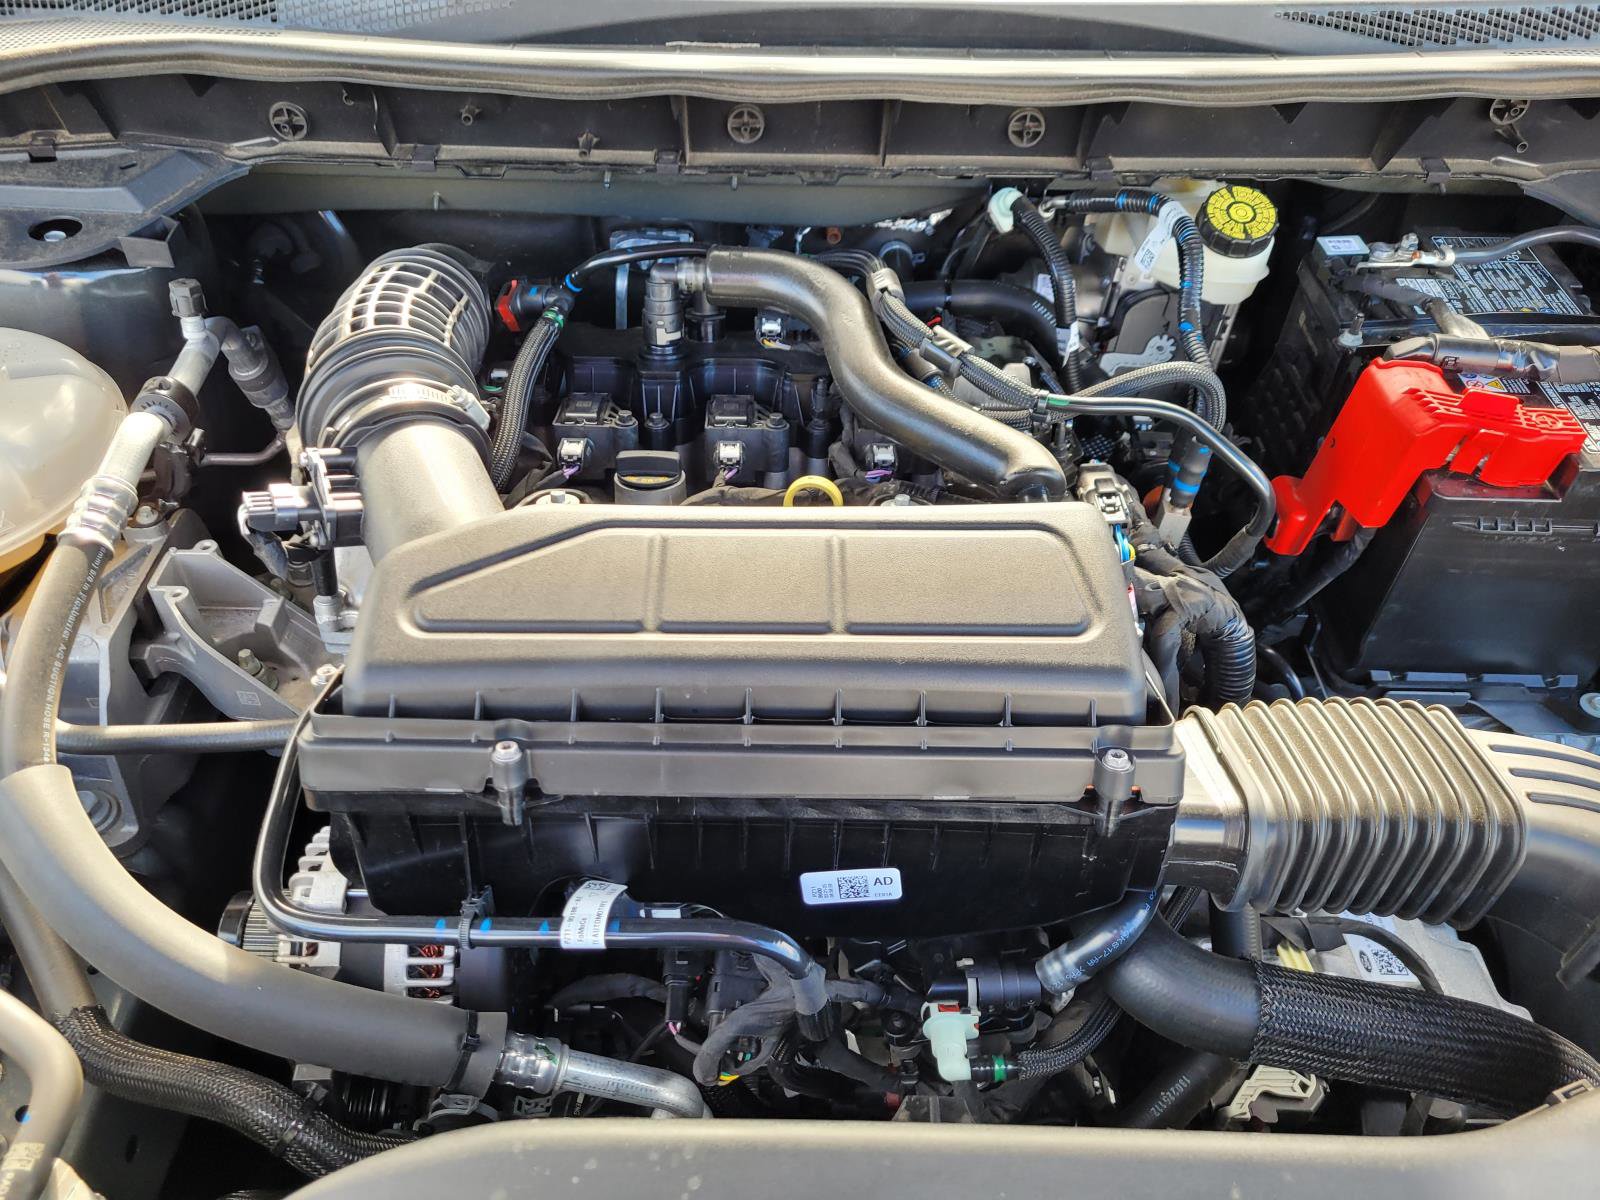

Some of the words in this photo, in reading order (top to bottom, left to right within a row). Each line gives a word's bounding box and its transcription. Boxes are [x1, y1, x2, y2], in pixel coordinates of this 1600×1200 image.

[57, 643, 68, 660] A/C
[47, 658, 62, 701] SUCTION
[42, 700, 54, 730] HOSE
[873, 876, 893, 886] AD
